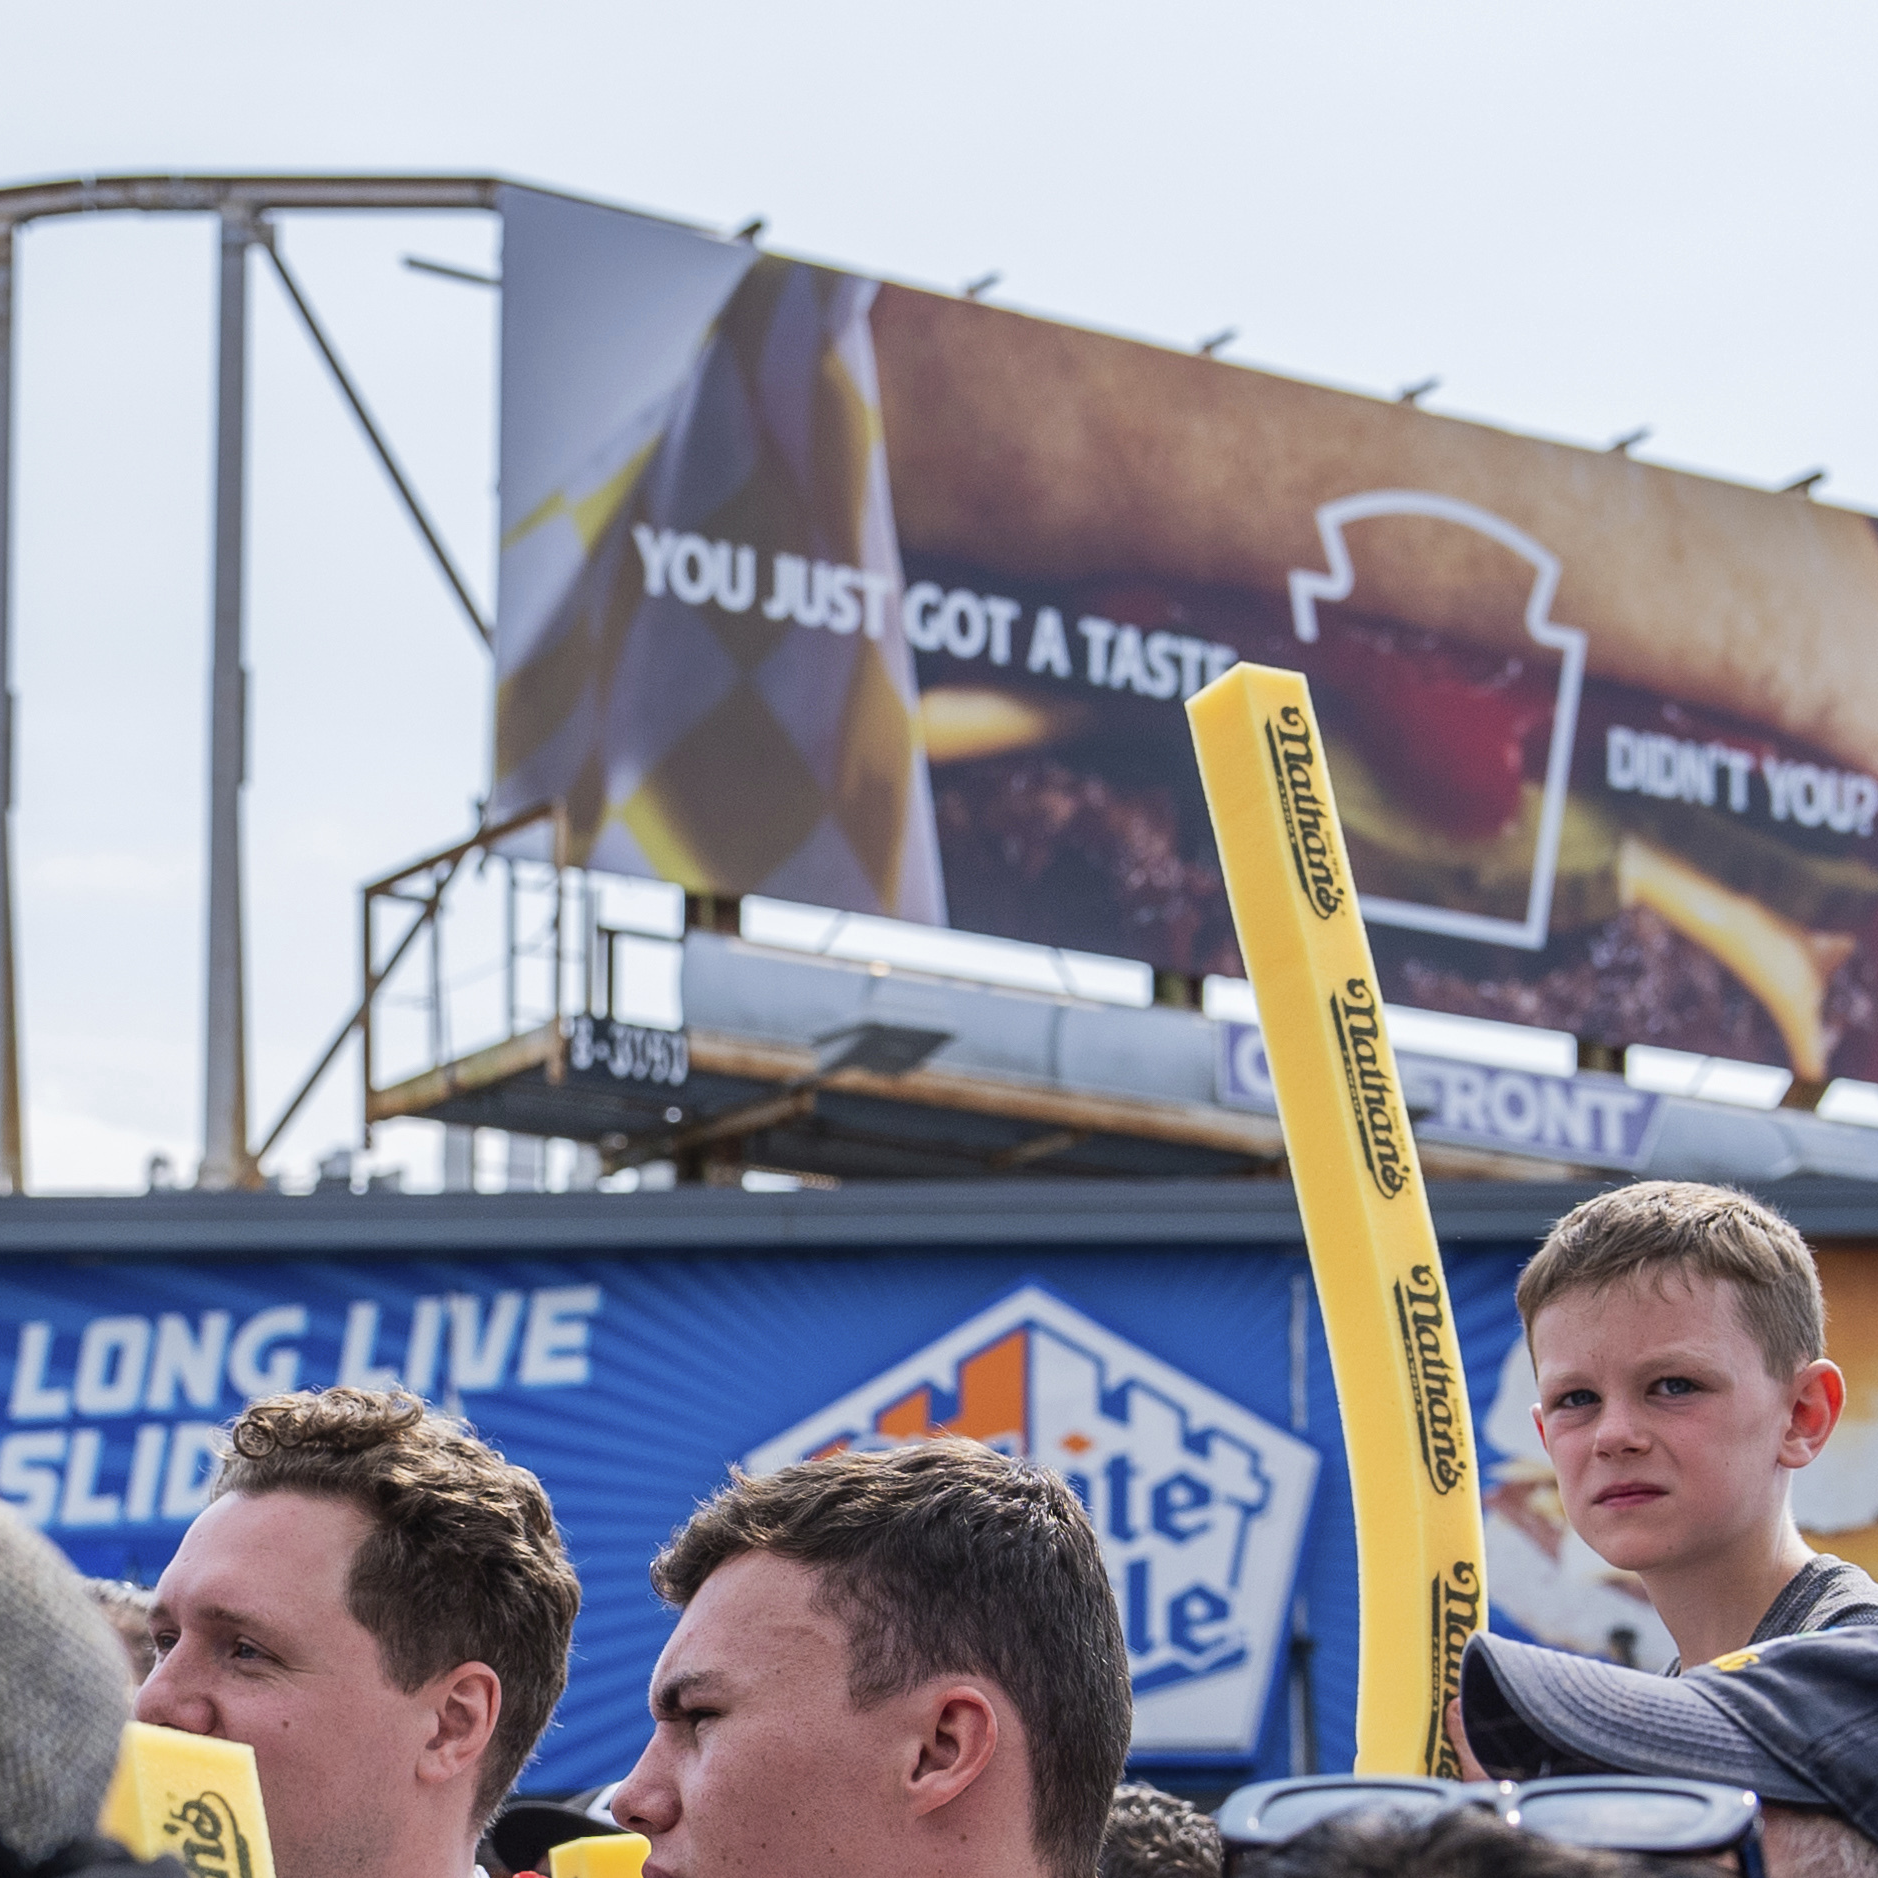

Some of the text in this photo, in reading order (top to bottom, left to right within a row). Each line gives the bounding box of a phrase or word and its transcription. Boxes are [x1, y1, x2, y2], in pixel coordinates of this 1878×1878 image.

[634, 524, 757, 612] YOU
[763, 552, 896, 640] JUST
[900, 582, 1020, 665] GOT
[1027, 606, 1072, 679] A
[1276, 706, 1345, 914] Nathan's
[1607, 725, 1754, 813] DIDN'T
[1341, 978, 1410, 1192] Nathan's
[8, 1284, 602, 1421] LONG LIVE
[1406, 1264, 1467, 1488] Nathan's
